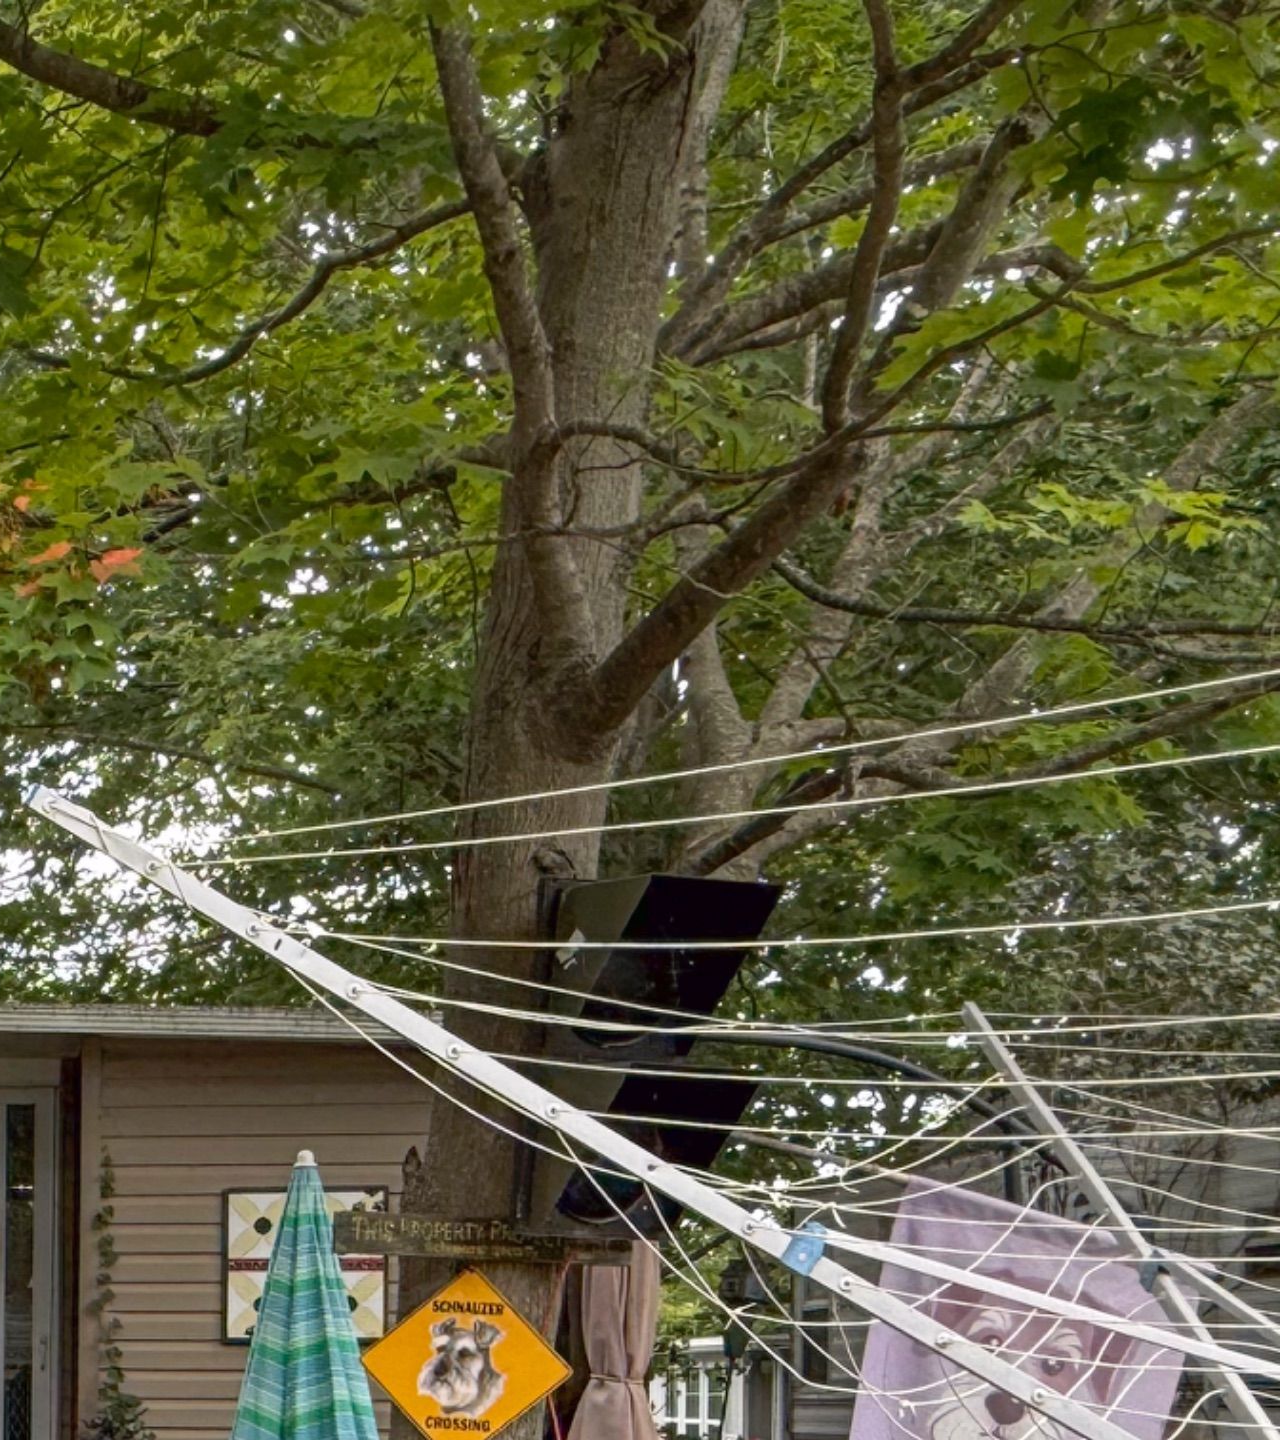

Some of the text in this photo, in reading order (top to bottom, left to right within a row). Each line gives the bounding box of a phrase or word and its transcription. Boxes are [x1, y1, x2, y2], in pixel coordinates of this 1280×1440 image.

[352, 1216, 395, 1242] THIS
[432, 1300, 504, 1316] SCHNAUZER
[425, 1417, 491, 1432] CROSSING
